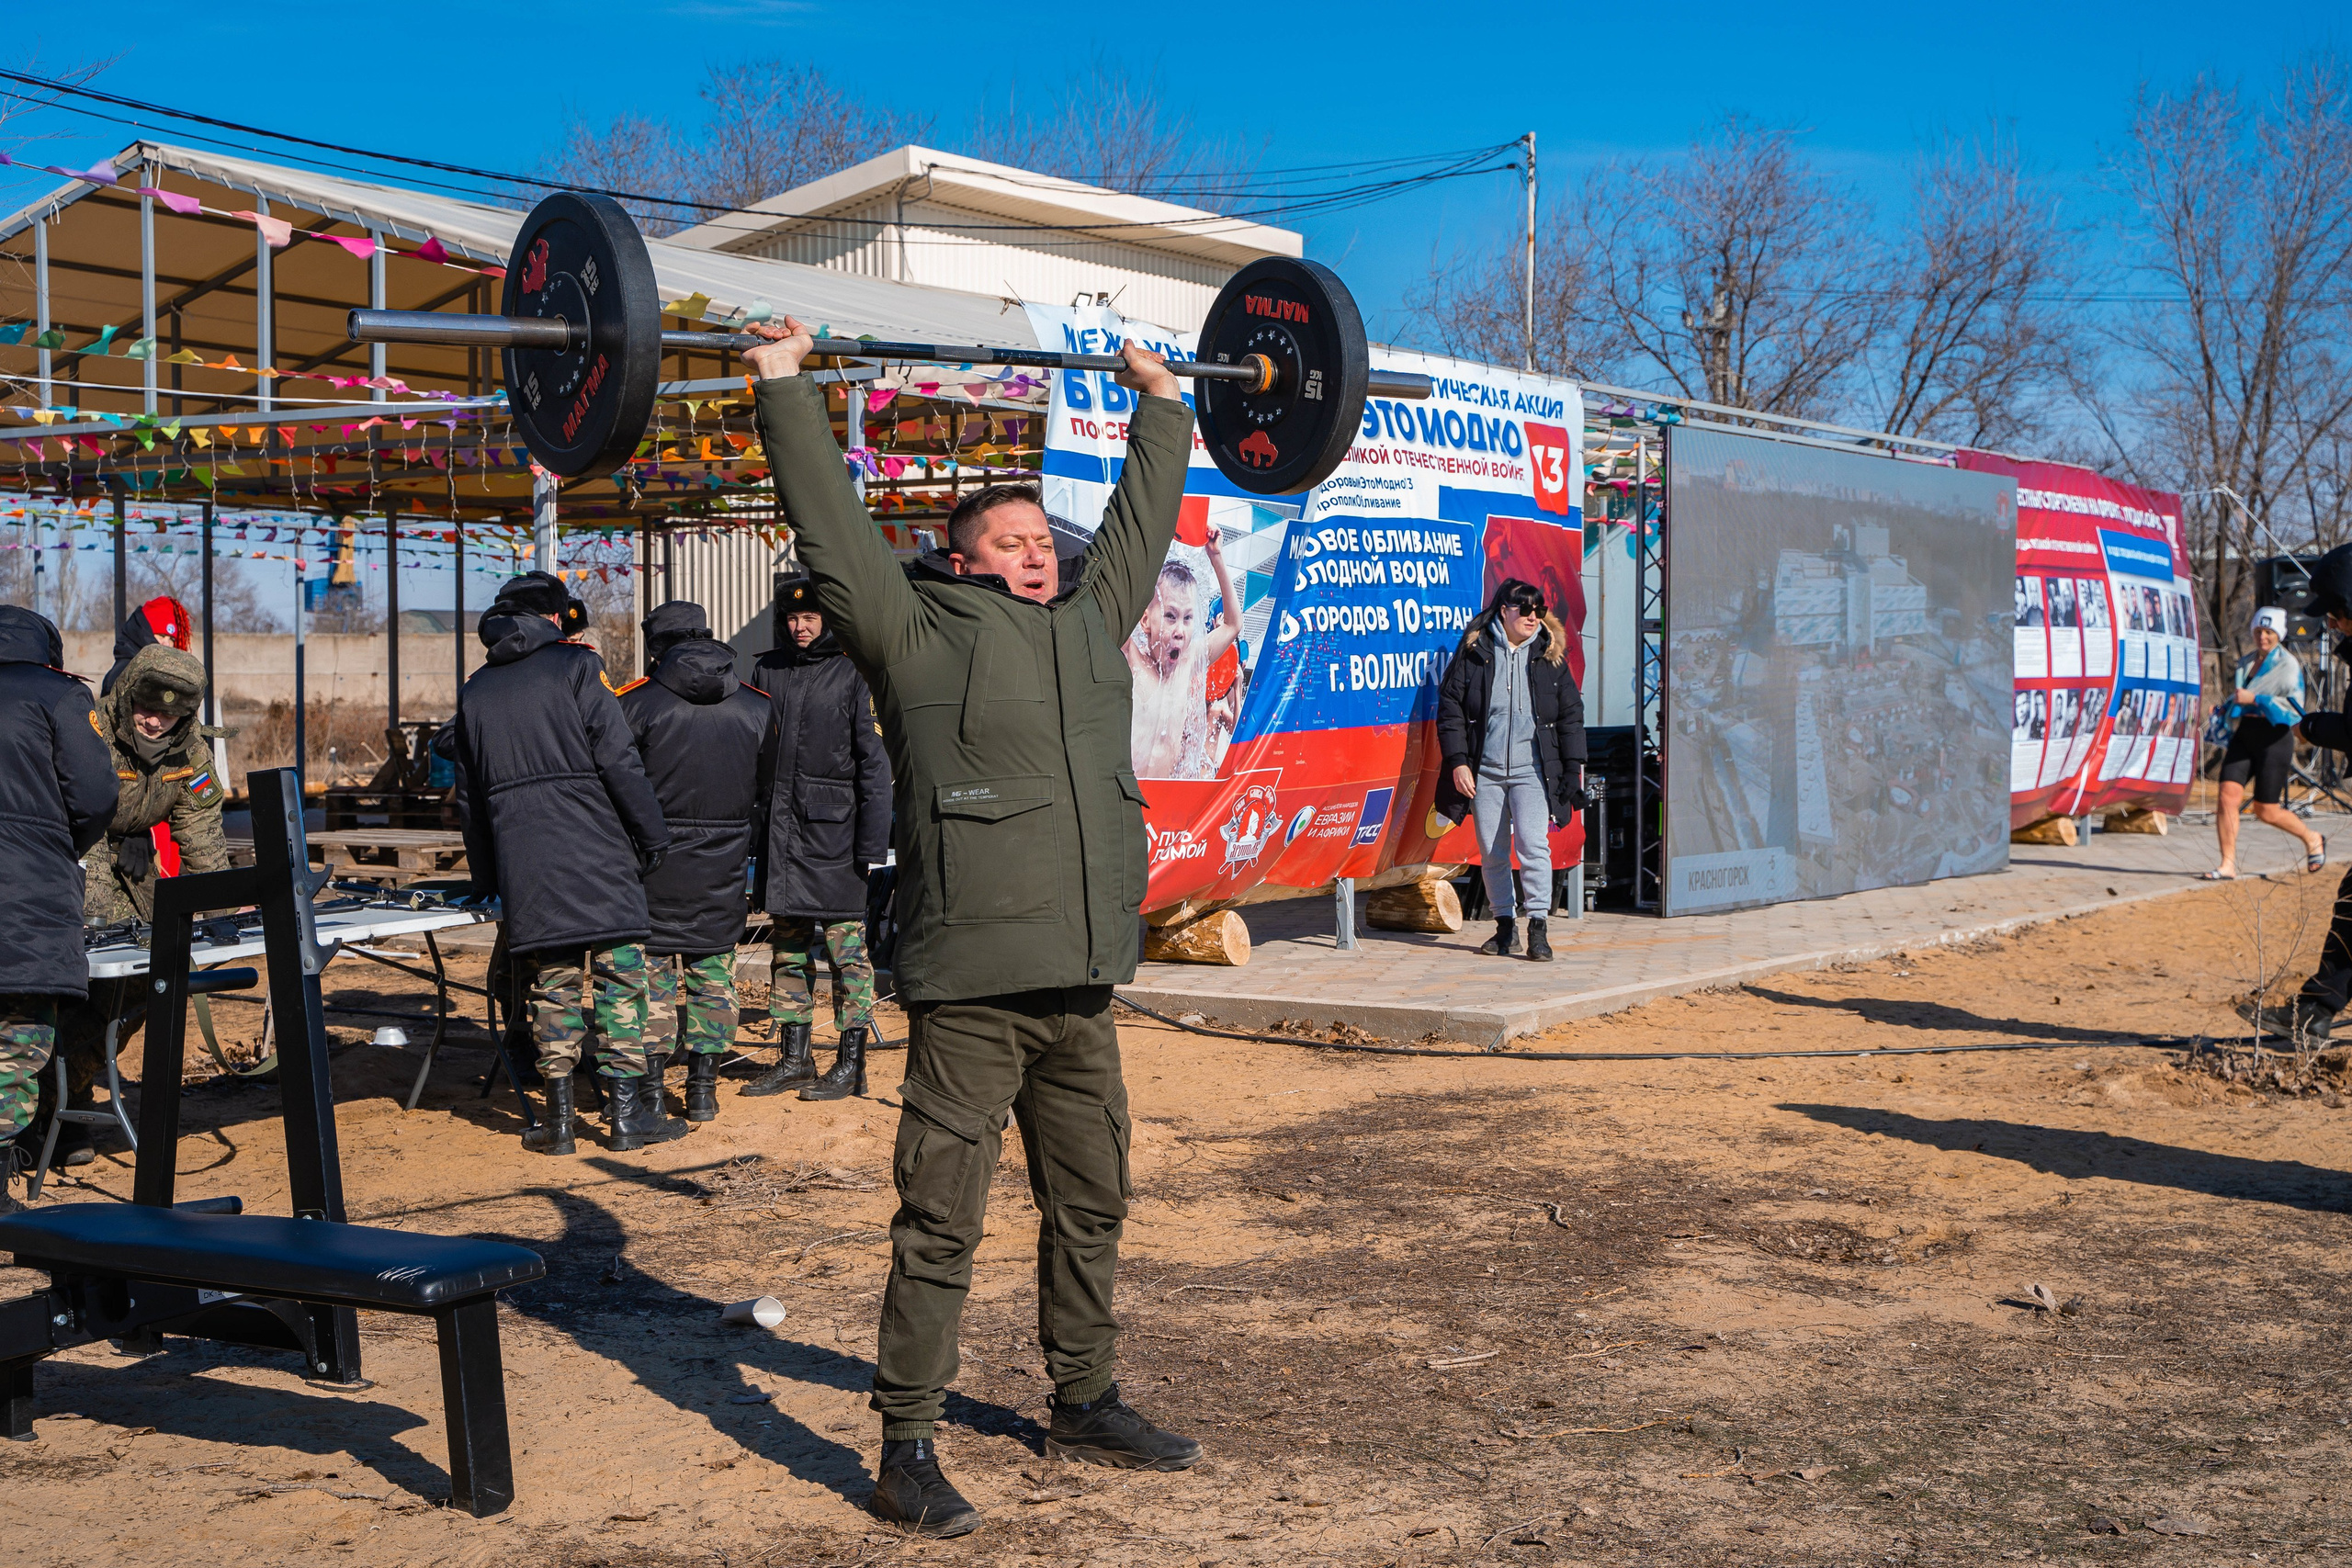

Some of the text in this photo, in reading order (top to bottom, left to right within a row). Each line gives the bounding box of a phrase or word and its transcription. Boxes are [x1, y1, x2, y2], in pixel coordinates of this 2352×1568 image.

[1245, 294, 1310, 323] МАГМА
[523, 371, 540, 404] 15
[1309, 369, 1323, 379] KG
[562, 354, 611, 443] МАГМА
[1304, 379, 1323, 400] 15
[1514, 391, 1564, 420] АКЦИЯ
[1532, 445, 1564, 493] 13
[1362, 529, 1464, 557] ОБЛИВАНИЕ
[1389, 556, 1450, 588] ВОДОЙ
[1299, 605, 1390, 636] ГОРОДОВ
[1393, 598, 1421, 634] 10
[1422, 604, 1474, 631] СТРАН
[1350, 652, 1453, 691] ВОЛЖСКИ
[968, 787, 990, 795] WEAR
[1314, 810, 1356, 826] ЕВРАЗИИ
[1317, 825, 1351, 839] АФРИКИ
[1688, 865, 1750, 892] КРАСНОГОРСК
